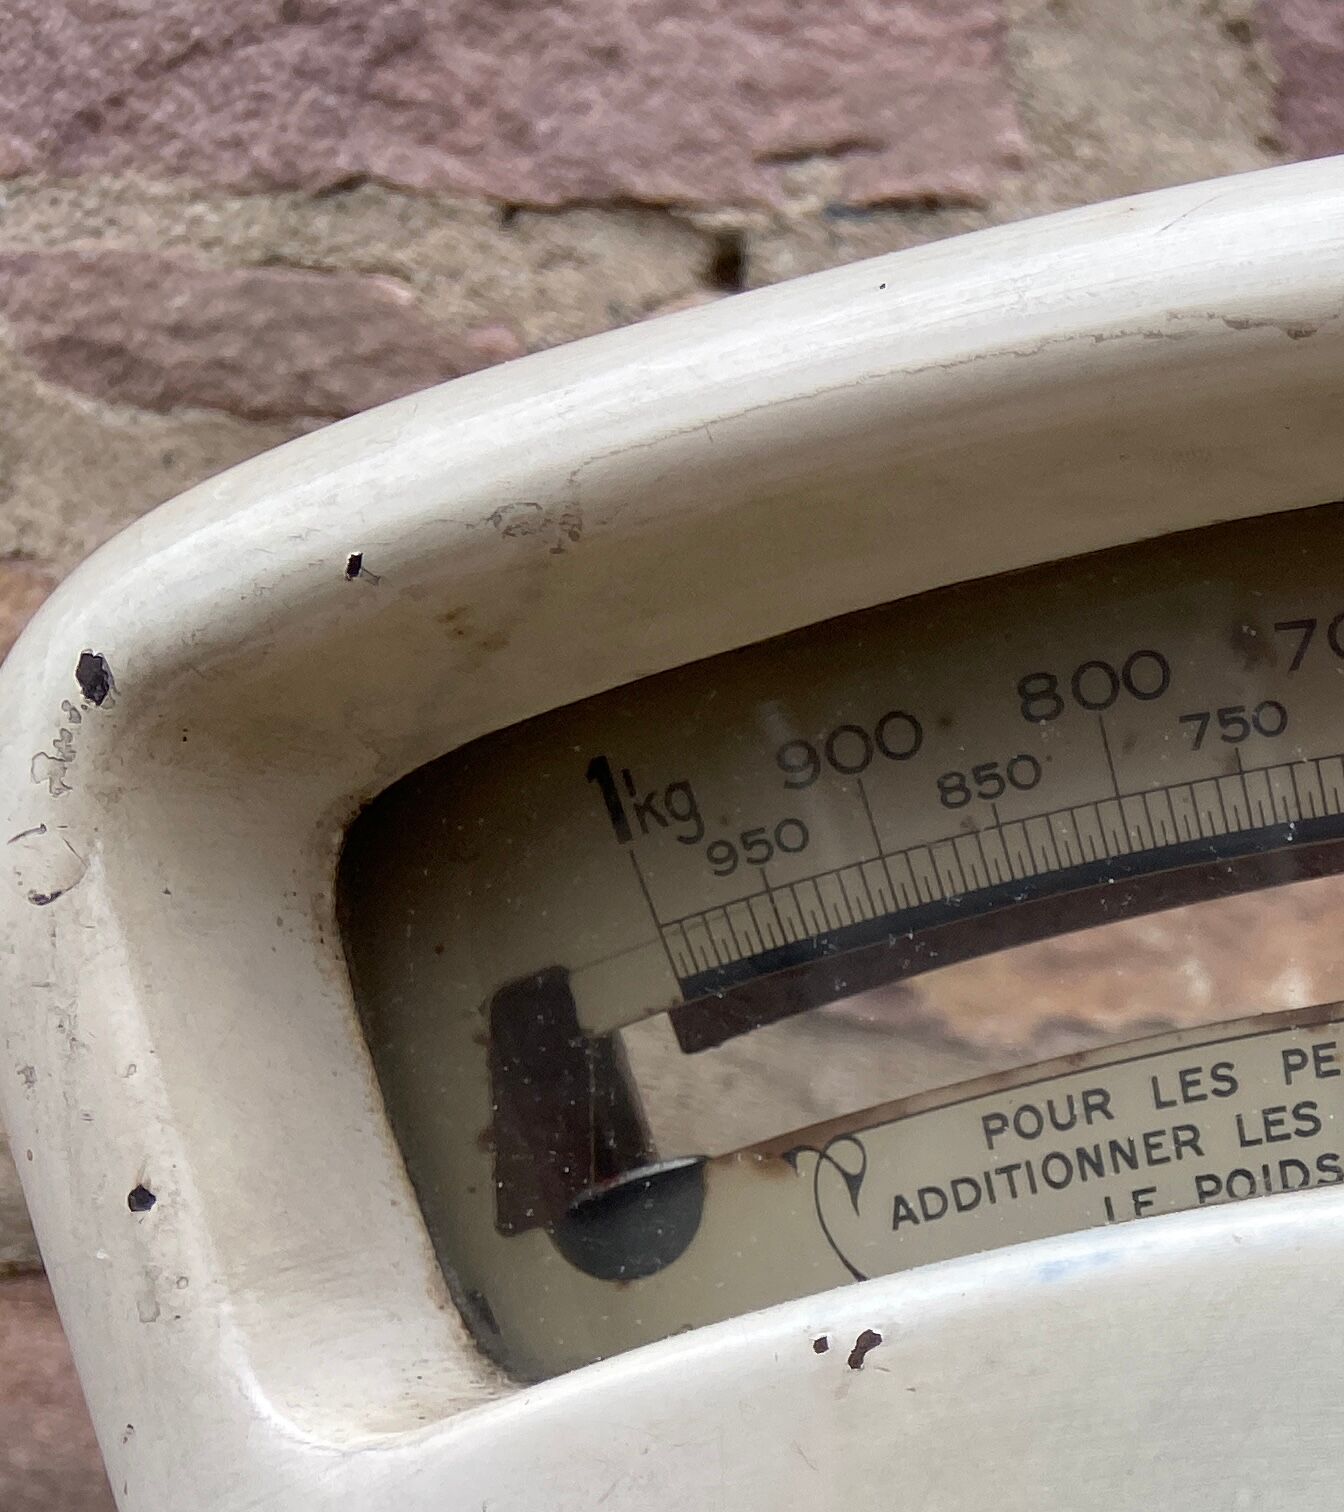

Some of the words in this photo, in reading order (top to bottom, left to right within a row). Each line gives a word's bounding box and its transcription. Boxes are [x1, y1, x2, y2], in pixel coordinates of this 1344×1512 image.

[775, 710, 923, 790] 900
[1016, 649, 1171, 724] 800
[706, 817, 810, 878] 950
[936, 754, 1042, 809] 850
[1179, 700, 1288, 751] 750
[891, 1123, 1205, 1231] ADDITIONNER
[1235, 1099, 1323, 1149] LES
[981, 1087, 1114, 1151] POUR
[1151, 1061, 1239, 1111] LES
